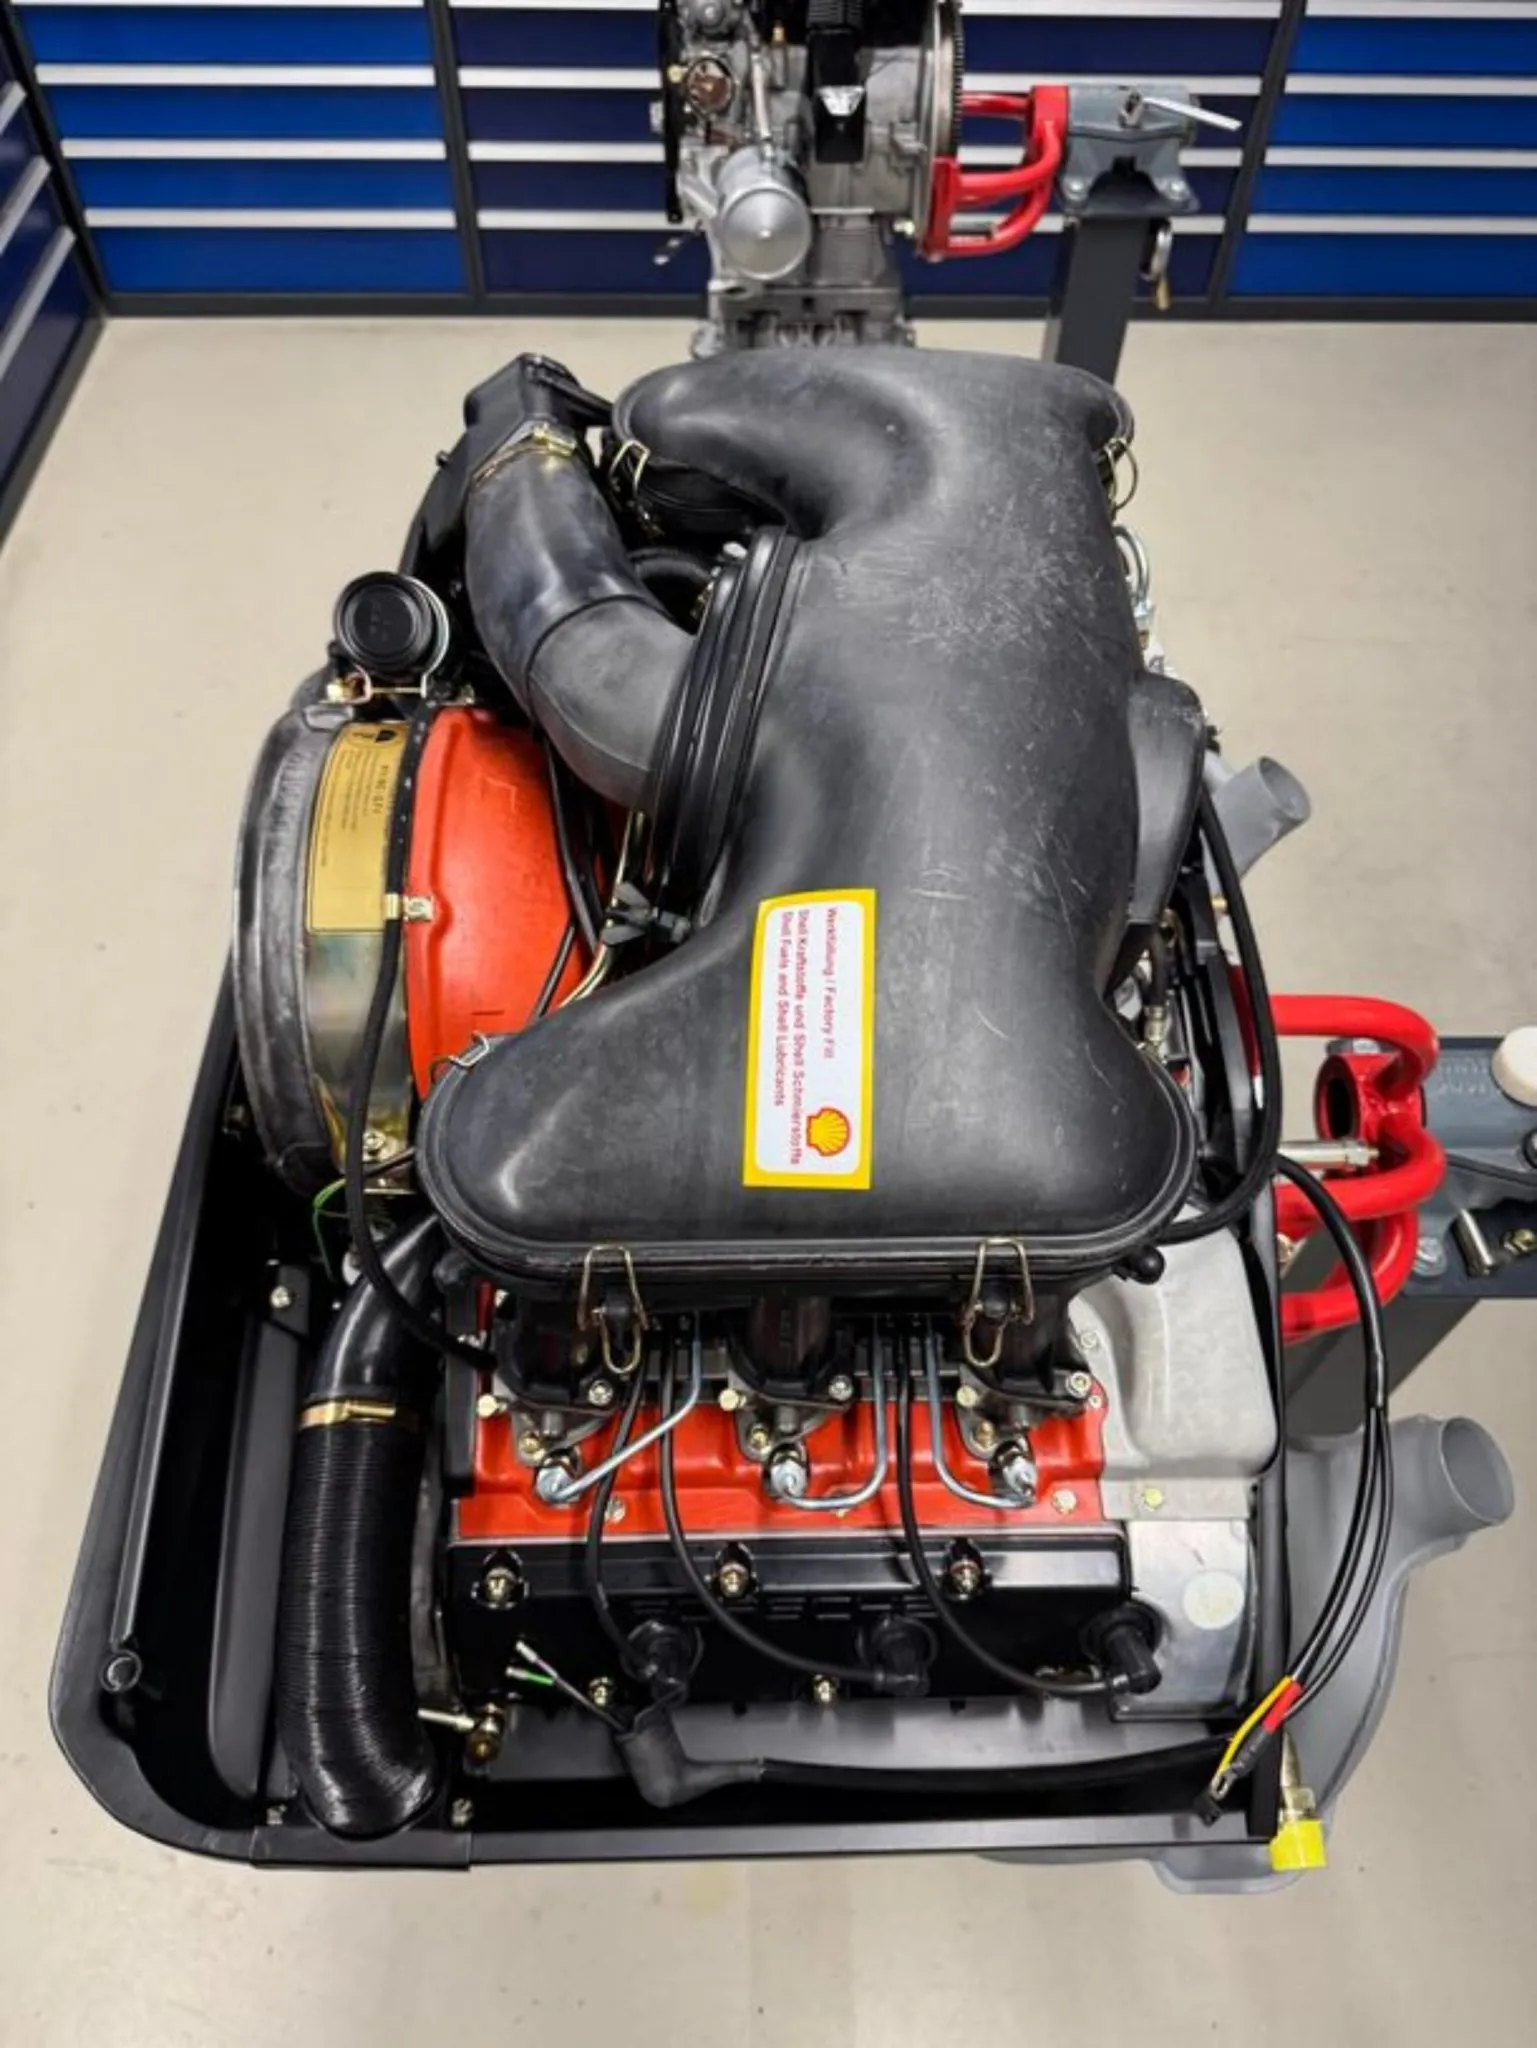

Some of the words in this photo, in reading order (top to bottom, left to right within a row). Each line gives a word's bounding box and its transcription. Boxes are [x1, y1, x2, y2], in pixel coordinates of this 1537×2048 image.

[798, 910, 810, 935] Shell
[780, 939, 792, 968] Fuels
[795, 938, 808, 1000] Kraftstoffe
[778, 973, 790, 996] and
[777, 1000, 789, 1033] Shell
[794, 1004, 806, 1029] und
[821, 987, 836, 1034] Factory
[793, 1034, 806, 1066] Shell
[823, 1038, 835, 1059] Fill
[774, 1035, 788, 1106] Lubricants
[791, 1070, 805, 1164] Schmierstoffe
